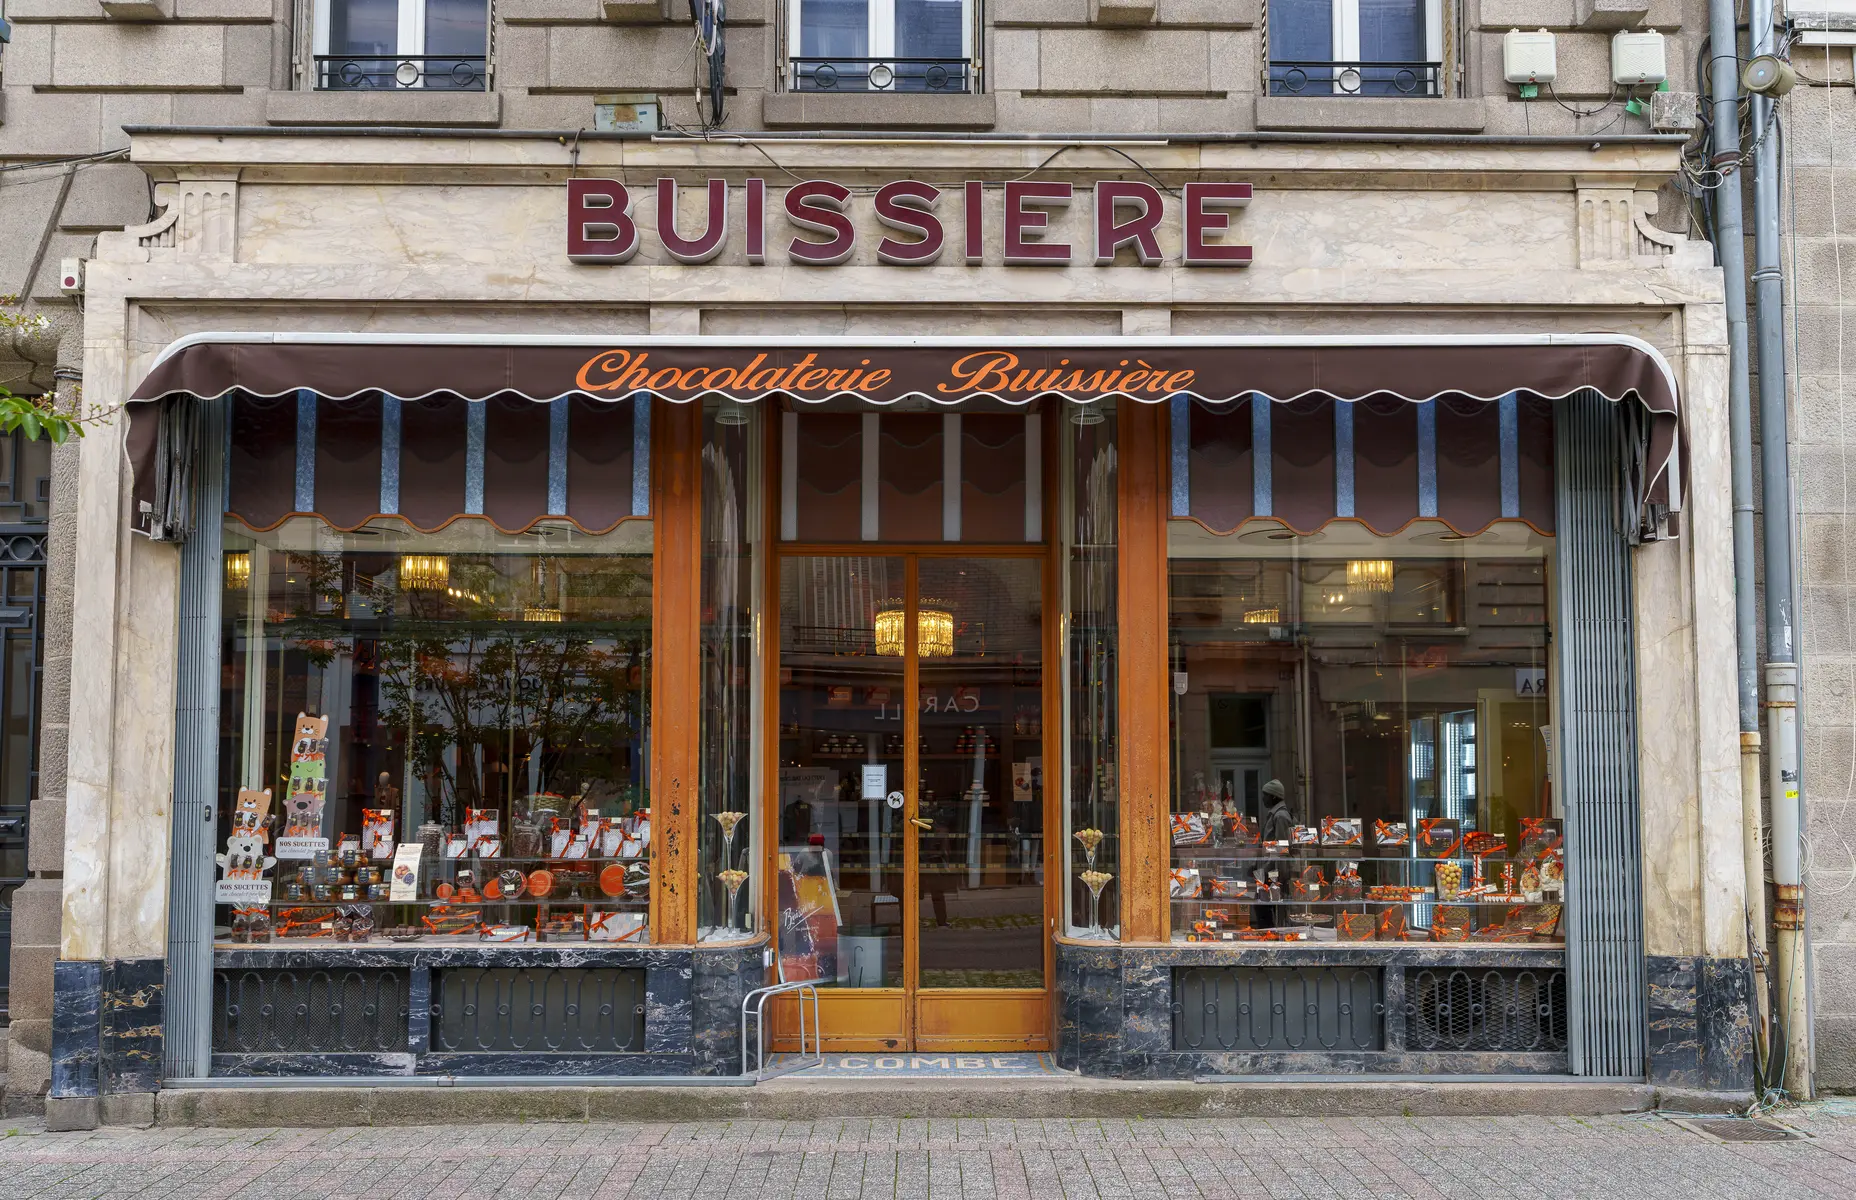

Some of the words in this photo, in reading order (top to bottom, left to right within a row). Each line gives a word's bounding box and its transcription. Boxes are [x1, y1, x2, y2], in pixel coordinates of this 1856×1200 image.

[566, 177, 1253, 268] BUISSIERE
[575, 349, 893, 391] Chocolaterie
[936, 350, 1196, 393] Buissière
[839, 1057, 1027, 1070] COMBE
